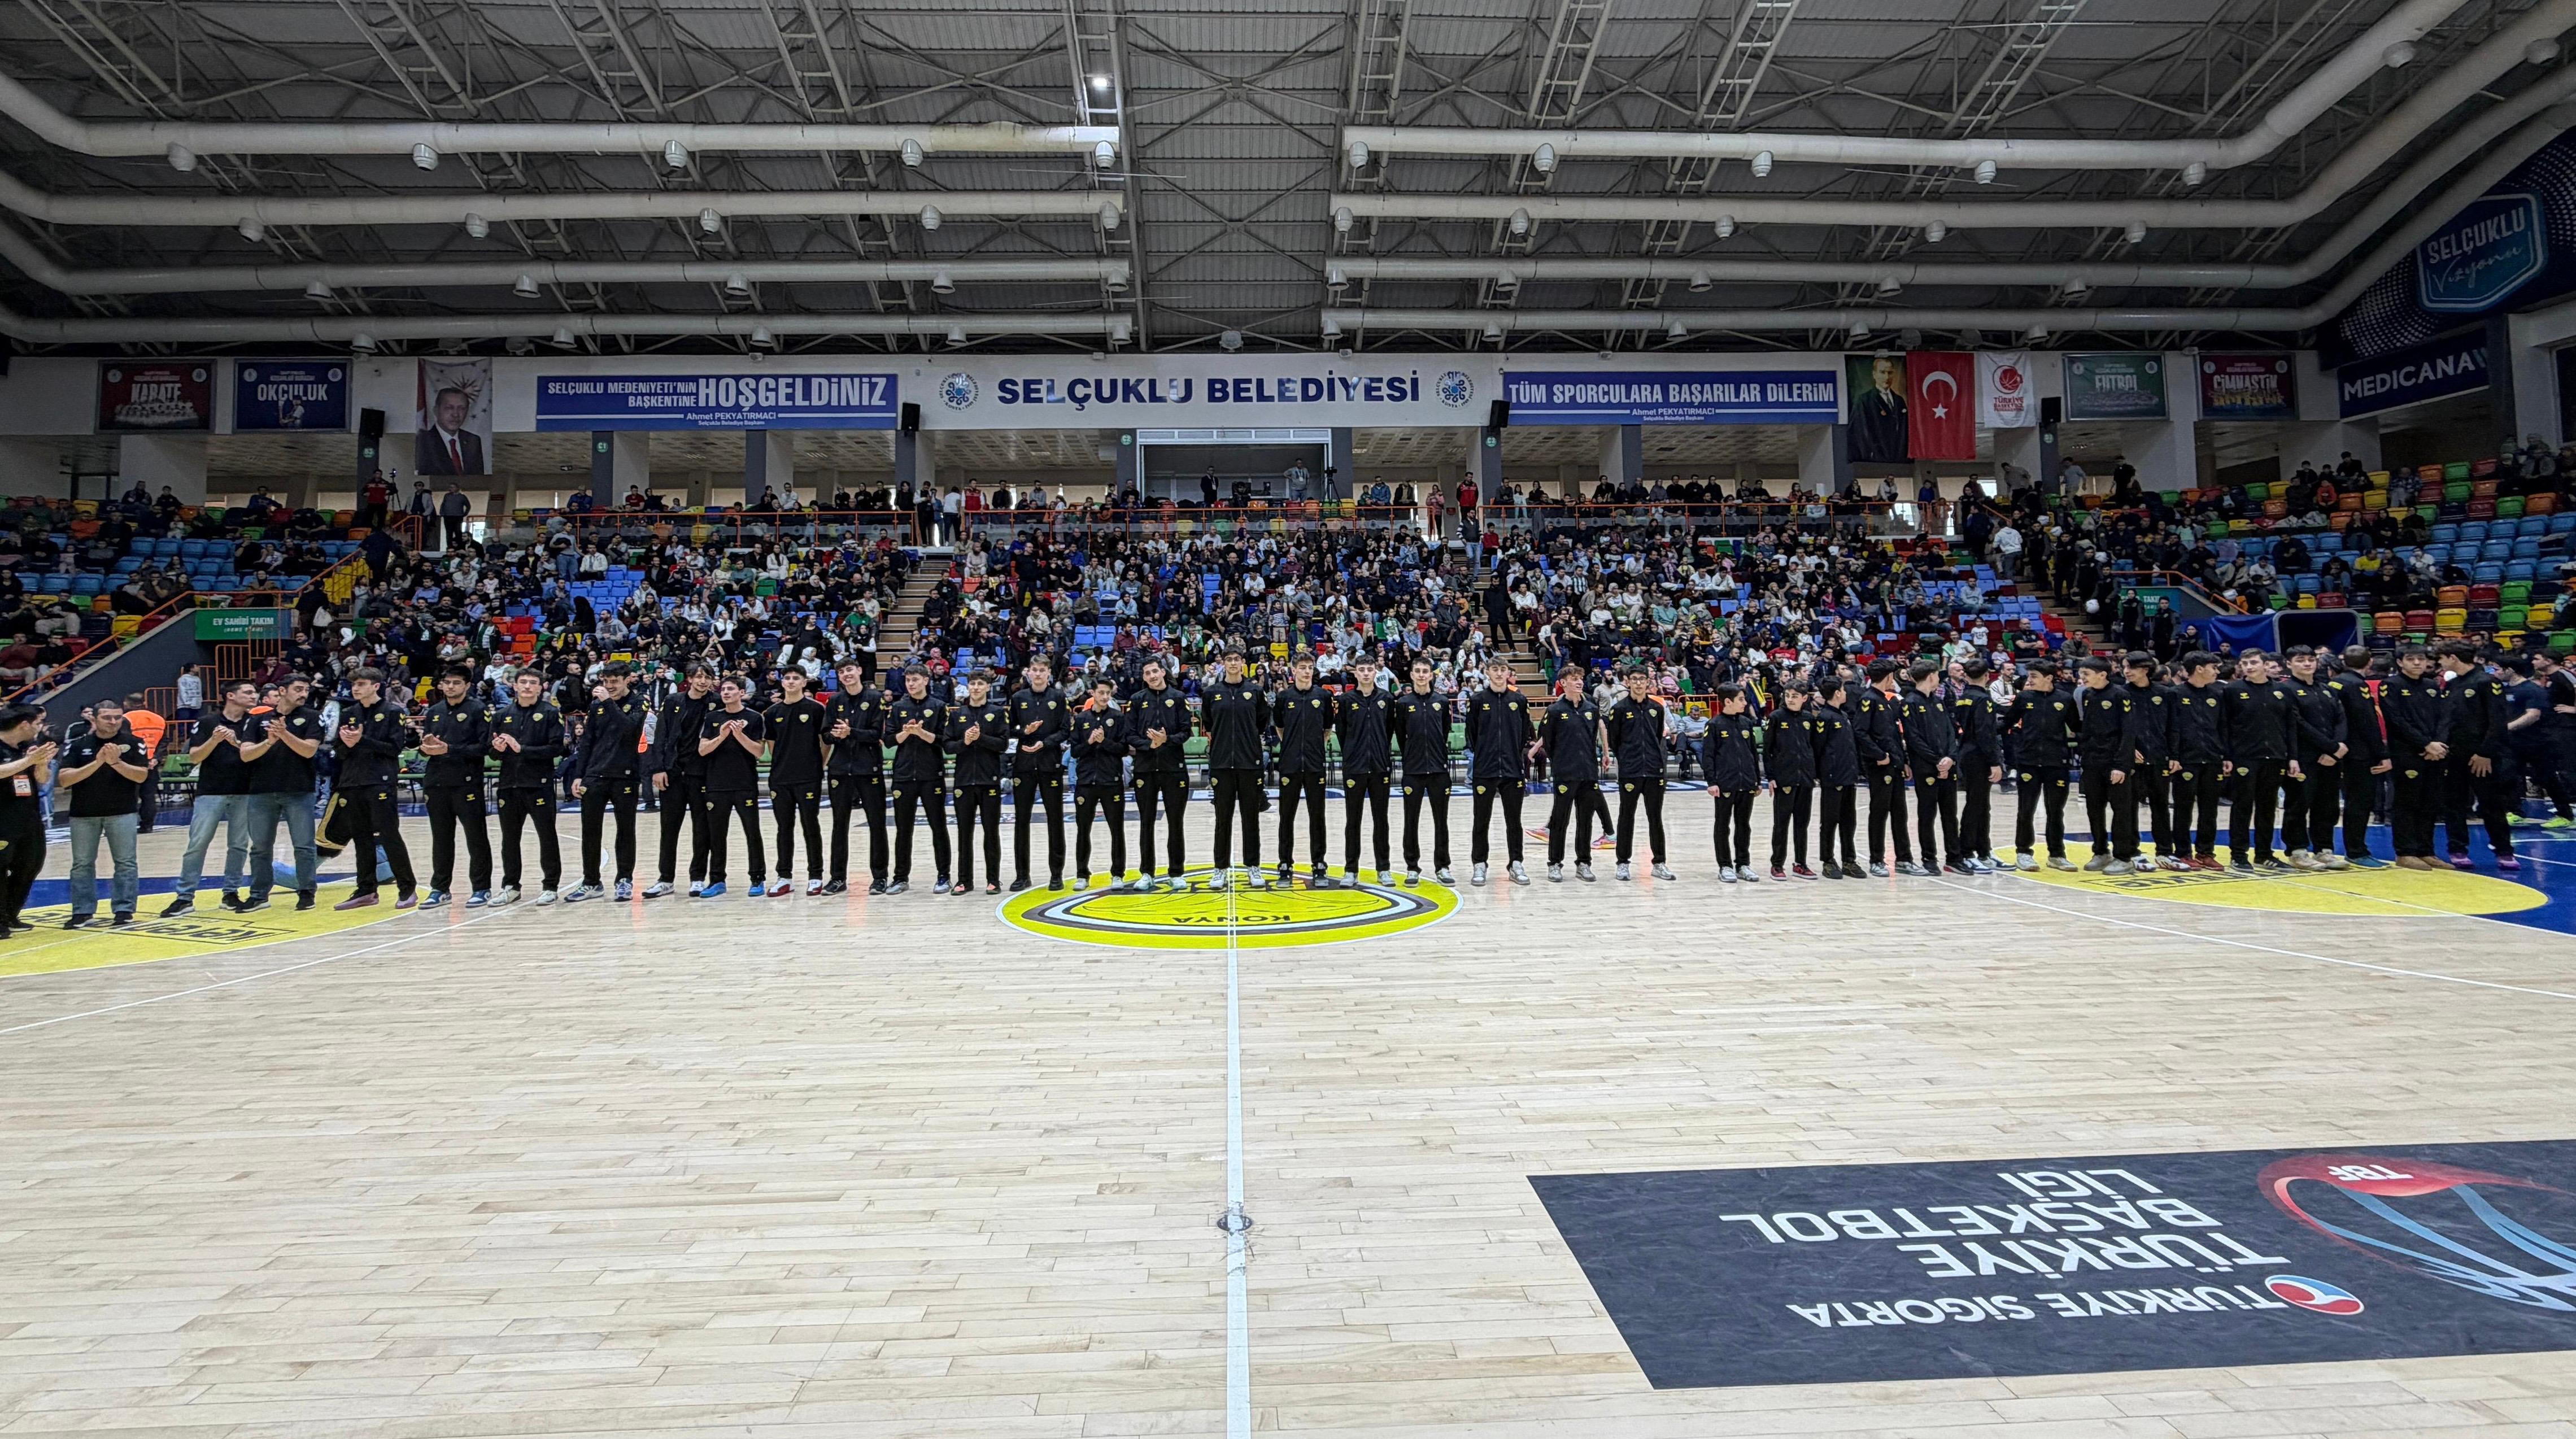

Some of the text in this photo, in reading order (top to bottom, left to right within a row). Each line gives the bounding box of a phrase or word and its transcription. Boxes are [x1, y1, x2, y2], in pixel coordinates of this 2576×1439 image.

[2428, 206, 2525, 264] SELÇUKLU
[548, 381, 696, 395] SELÇUKLU MEDENİYETİ'NİN
[997, 370, 1419, 411] SELÇUKLU BELEDİYESİ
[2344, 352, 2476, 402] MEDICANA
[628, 395, 696, 409] BAŞKENTİNE
[699, 377, 886, 411] HOŞGELDİNİZ
[1509, 381, 1834, 407] TÜM SPORCULARA BAŞARILAR DİLERİM
[250, 617, 274, 625] TAKIM
[1173, 915, 1291, 925] KONYA
[1997, 1169, 2163, 1202] LİGİ
[2328, 1165, 2413, 1181] TBF
[1719, 1197, 2223, 1244] BASKETBOL
[1897, 1232, 2292, 1279] TÜRKİYE
[1786, 1284, 2290, 1328] TÜRKİYE SİGORTA
